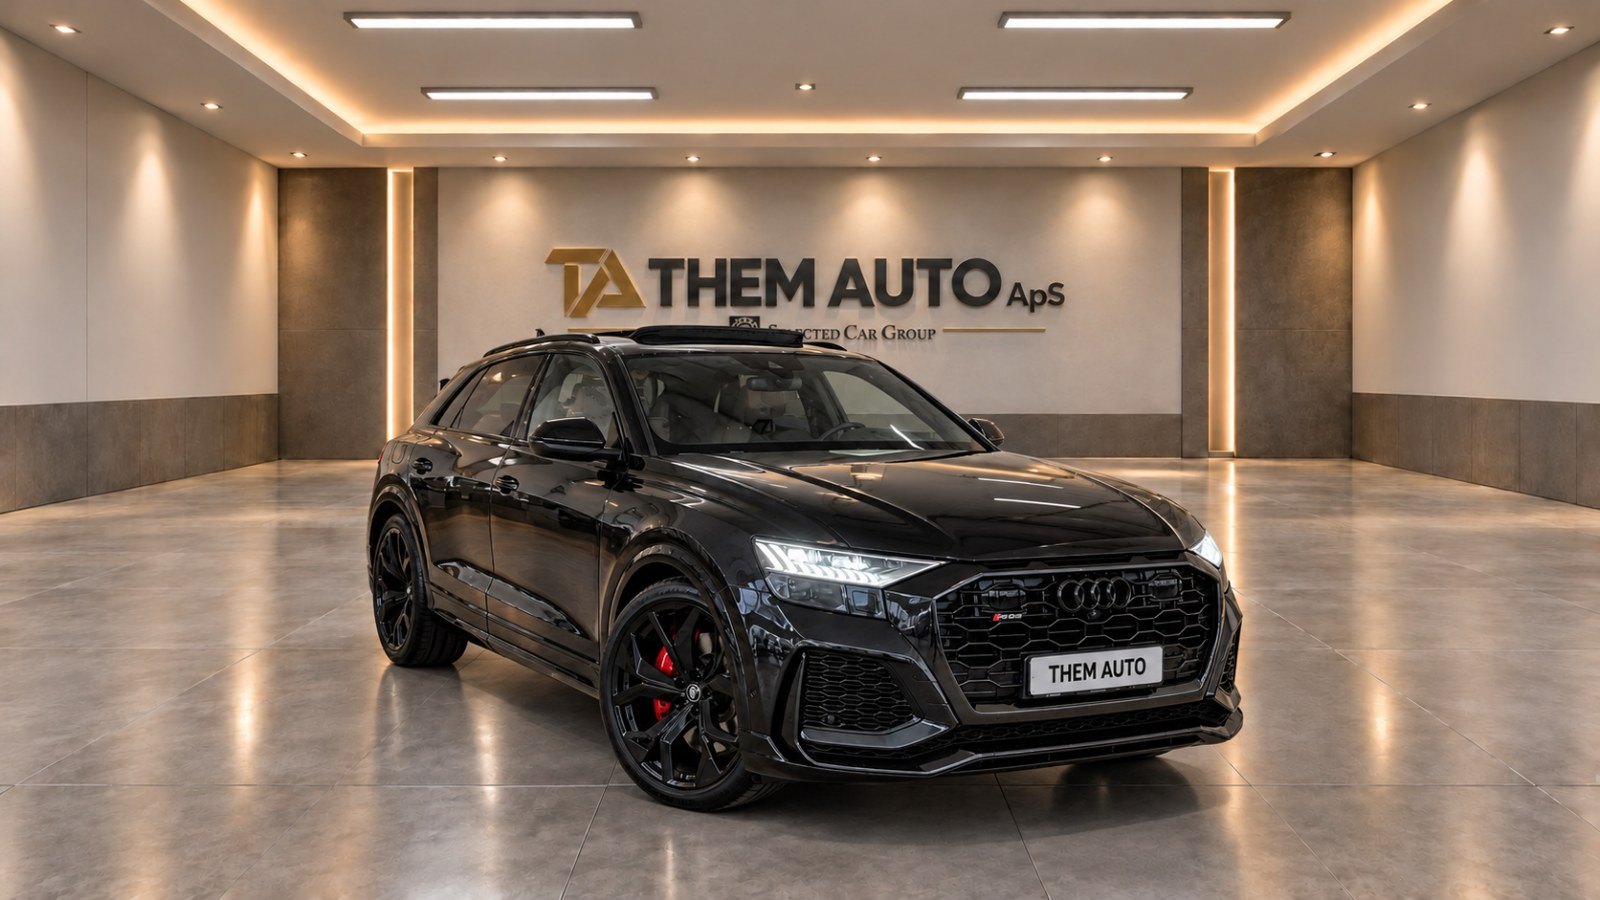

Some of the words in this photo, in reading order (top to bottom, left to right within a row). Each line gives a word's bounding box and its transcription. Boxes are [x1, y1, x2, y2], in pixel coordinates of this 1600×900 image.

[648, 258, 815, 309] THEM
[828, 257, 1001, 309] AUTO
[1006, 281, 1065, 315] ApS
[1048, 662, 1097, 684] THEM
[1101, 658, 1146, 679] AUTO
